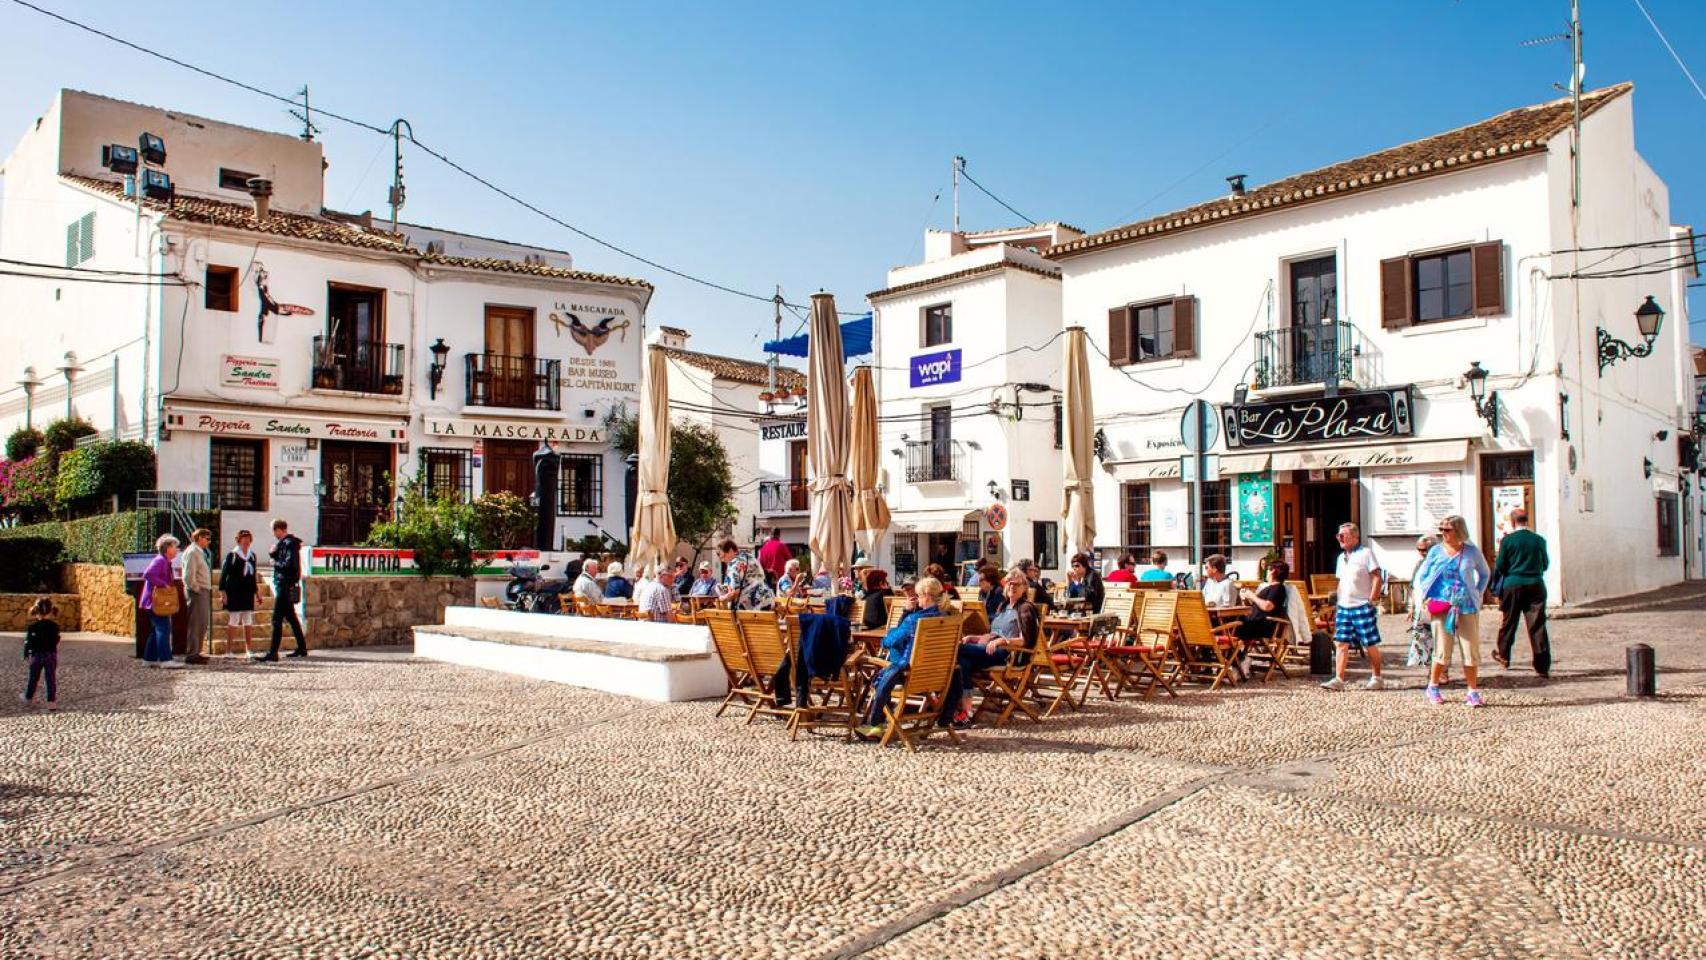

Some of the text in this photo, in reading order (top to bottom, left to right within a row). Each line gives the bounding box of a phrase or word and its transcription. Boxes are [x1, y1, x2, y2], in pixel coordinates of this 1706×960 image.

[554, 302, 625, 316] LA MASCARADA
[231, 367, 272, 378] Sandro
[568, 367, 617, 379] BAR MUSEO
[265, 419, 312, 435] Sandro
[325, 423, 378, 438] Trattoria
[1240, 399, 1394, 443] Bar La Plaza
[432, 421, 600, 441] LA MASCARADA
[762, 422, 808, 440] RESTAUR
[324, 553, 401, 573] TRATTORIA
